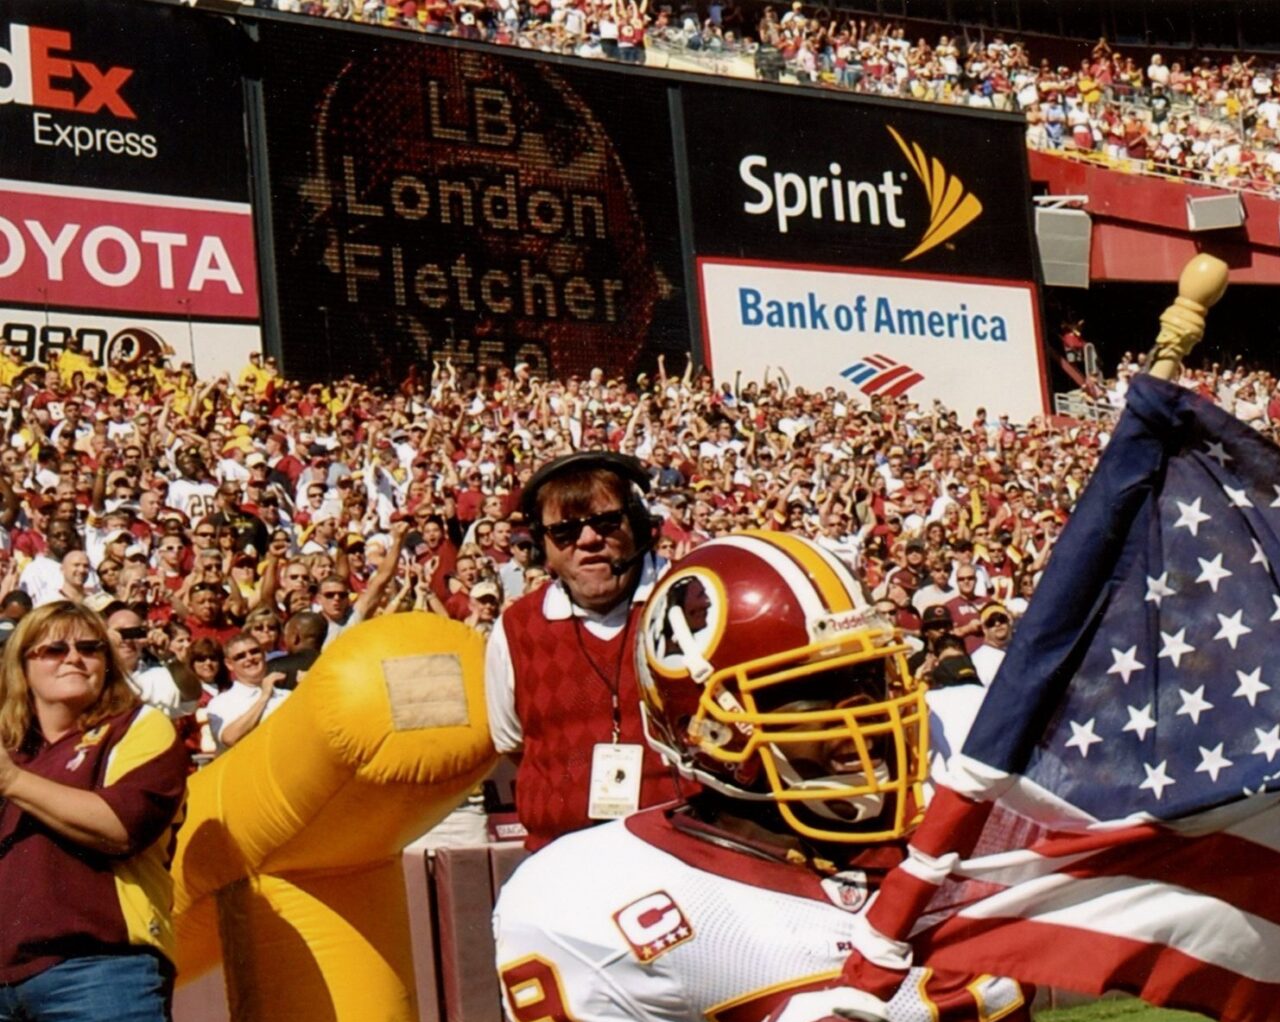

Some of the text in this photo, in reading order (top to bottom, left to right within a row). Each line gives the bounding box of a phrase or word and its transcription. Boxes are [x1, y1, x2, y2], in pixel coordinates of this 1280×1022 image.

[33, 112, 158, 158] Express
[429, 80, 516, 146] LB
[343, 155, 606, 239] London
[739, 154, 906, 233] Sprint
[343, 242, 624, 322] Fletcher
[739, 287, 1008, 342] Bank of America
